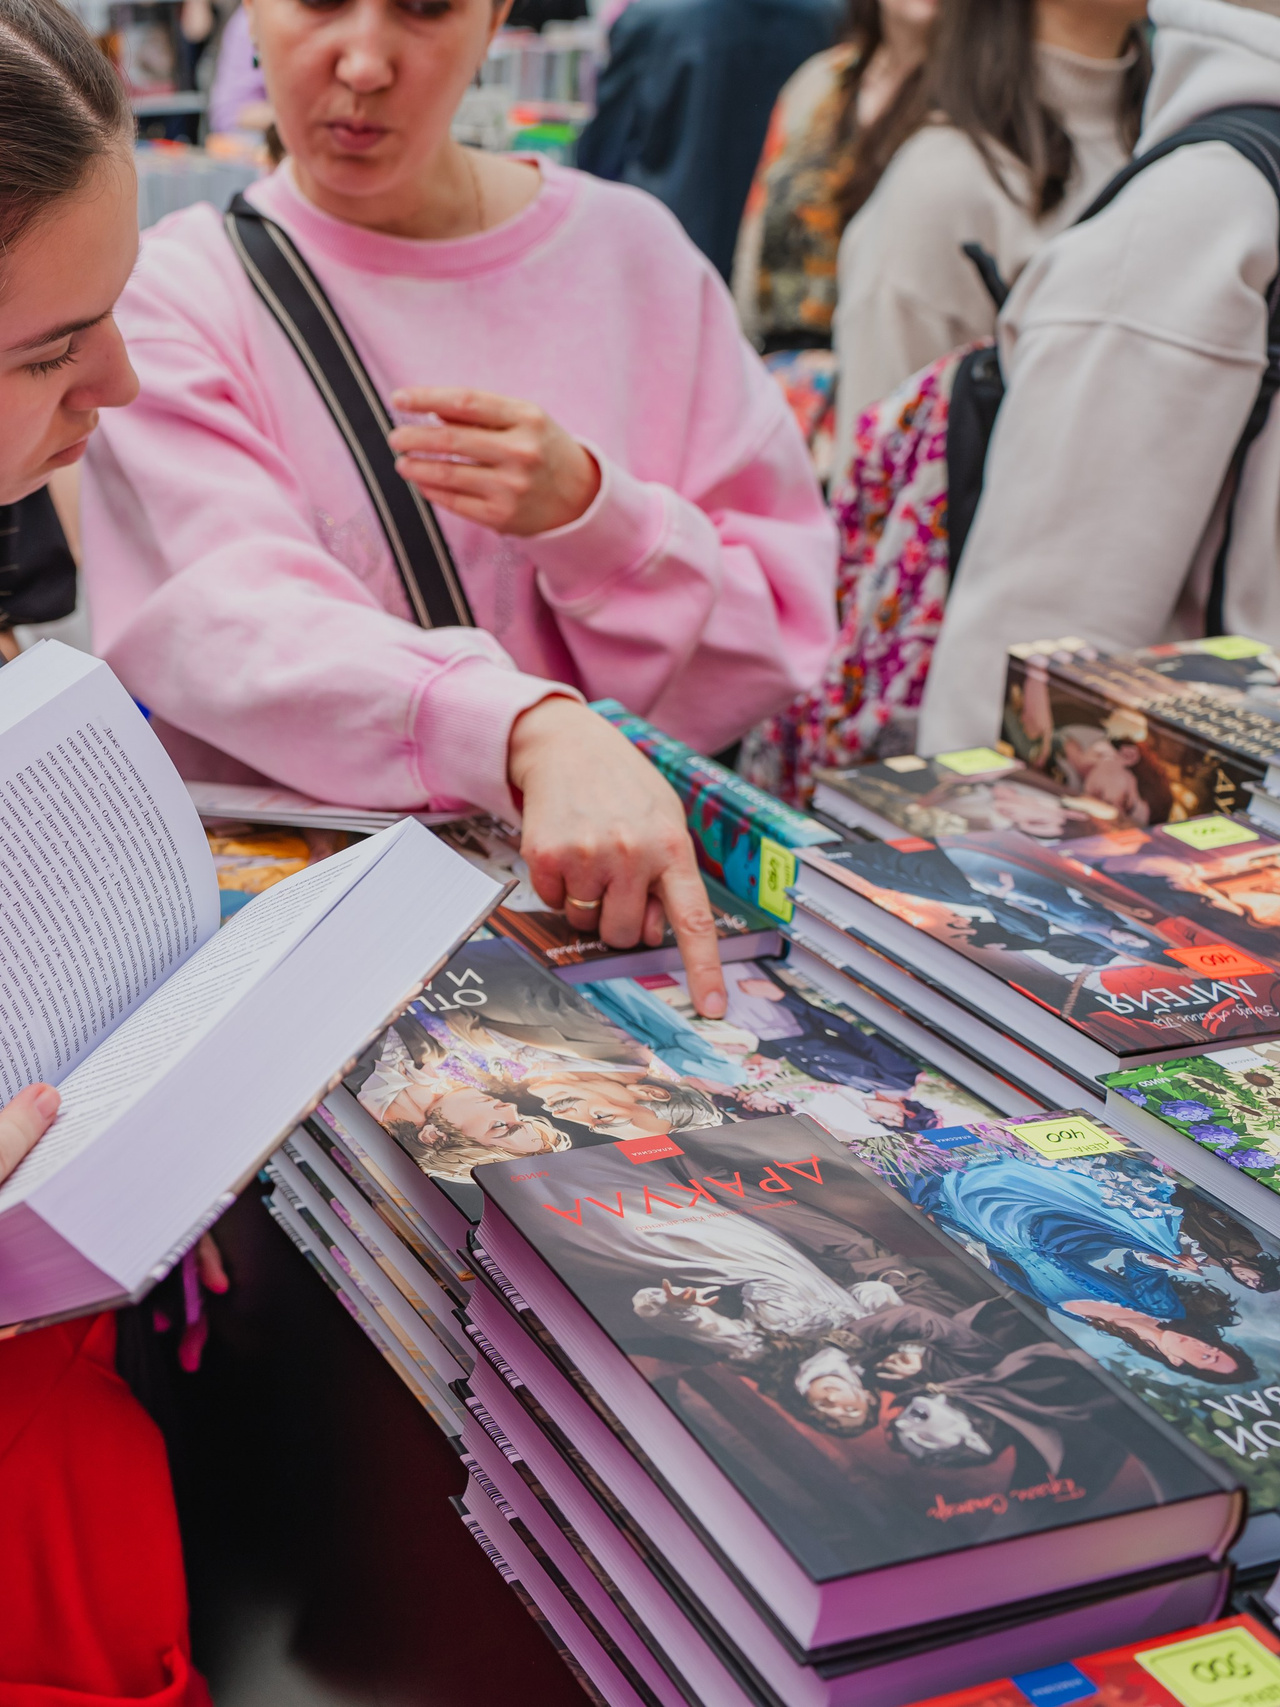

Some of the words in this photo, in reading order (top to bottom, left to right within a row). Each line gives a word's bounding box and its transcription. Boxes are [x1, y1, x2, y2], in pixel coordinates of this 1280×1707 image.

[15, 772, 34, 795] были
[31, 795, 45, 812] для
[42, 811, 64, 839] Дарьи
[76, 729, 99, 760] отчасти
[103, 769, 130, 809] ожидания
[127, 808, 141, 828] хотя
[143, 838, 166, 885] спокойной,
[85, 722, 103, 745] стала
[101, 745, 128, 785] купаться,
[131, 793, 144, 809] для
[140, 809, 158, 836] Дарьи
[102, 727, 120, 749] Даже
[118, 749, 148, 793] построили
[152, 805, 178, 856] соломенных
[175, 856, 188, 884] щитов
[5, 780, 34, 819] счастьем.
[34, 819, 51, 842] Если
[66, 868, 82, 892] было
[79, 892, 95, 920] этого,
[24, 765, 48, 793] роткие
[46, 793, 78, 838] спокойные
[75, 838, 99, 876] периоды.
[105, 890, 124, 926] хлопоты
[35, 758, 61, 790] дурного
[58, 790, 87, 830] характера
[113, 880, 128, 909] Редко,
[124, 908, 138, 933] редко
[46, 750, 59, 766] ему
[90, 813, 119, 865] чего-нибудь,
[119, 864, 141, 906] четвертый
[136, 906, 153, 948] выказывал
[66, 736, 82, 756] ской
[79, 755, 99, 784] жизни.
[98, 782, 129, 830] Спокойною
[129, 835, 147, 867] шестью
[143, 866, 159, 895] детьми
[154, 893, 166, 918] Дарья
[70, 764, 89, 788] могла
[86, 786, 101, 810] быть.
[101, 809, 117, 833] Один
[114, 832, 138, 875] заболевал,
[135, 874, 151, 902] другой
[0, 815, 13, 832] как
[20, 843, 43, 875] тяжелы
[40, 874, 57, 898] были
[53, 898, 66, 914] для
[63, 913, 81, 944] матери
[78, 944, 91, 967] страх
[2, 798, 27, 829] своими
[24, 828, 52, 866] мыслями
[54, 873, 70, 899] муже,
[69, 898, 91, 935] который
[92, 946, 105, 972] любит
[3, 842, 18, 862] горе
[20, 868, 37, 888] виду
[34, 888, 62, 932] признаков
[59, 932, 77, 964] дурных
[2, 909, 22, 938] золото
[24, 945, 40, 973] песке,
[44, 986, 61, 1017] дурные
[3, 935, 22, 964] песок;
[25, 973, 40, 997] были
[12, 900, 36, 937] Радости
[43, 953, 57, 978] были
[60, 959, 74, 988] теперь
[446, 968, 484, 987] И
[1200, 952, 1238, 966] 400
[6, 966, 21, 987] одно
[18, 987, 35, 1018] золото.
[11, 999, 24, 1022] чаще
[401, 989, 488, 1015] ОТЦ
[1095, 979, 1257, 1015] ЛИГЕЙЯ
[631, 1147, 674, 1157] КЛАССИКА
[1045, 1128, 1086, 1143] 400
[542, 1154, 823, 1226] ДРАКУЛА
